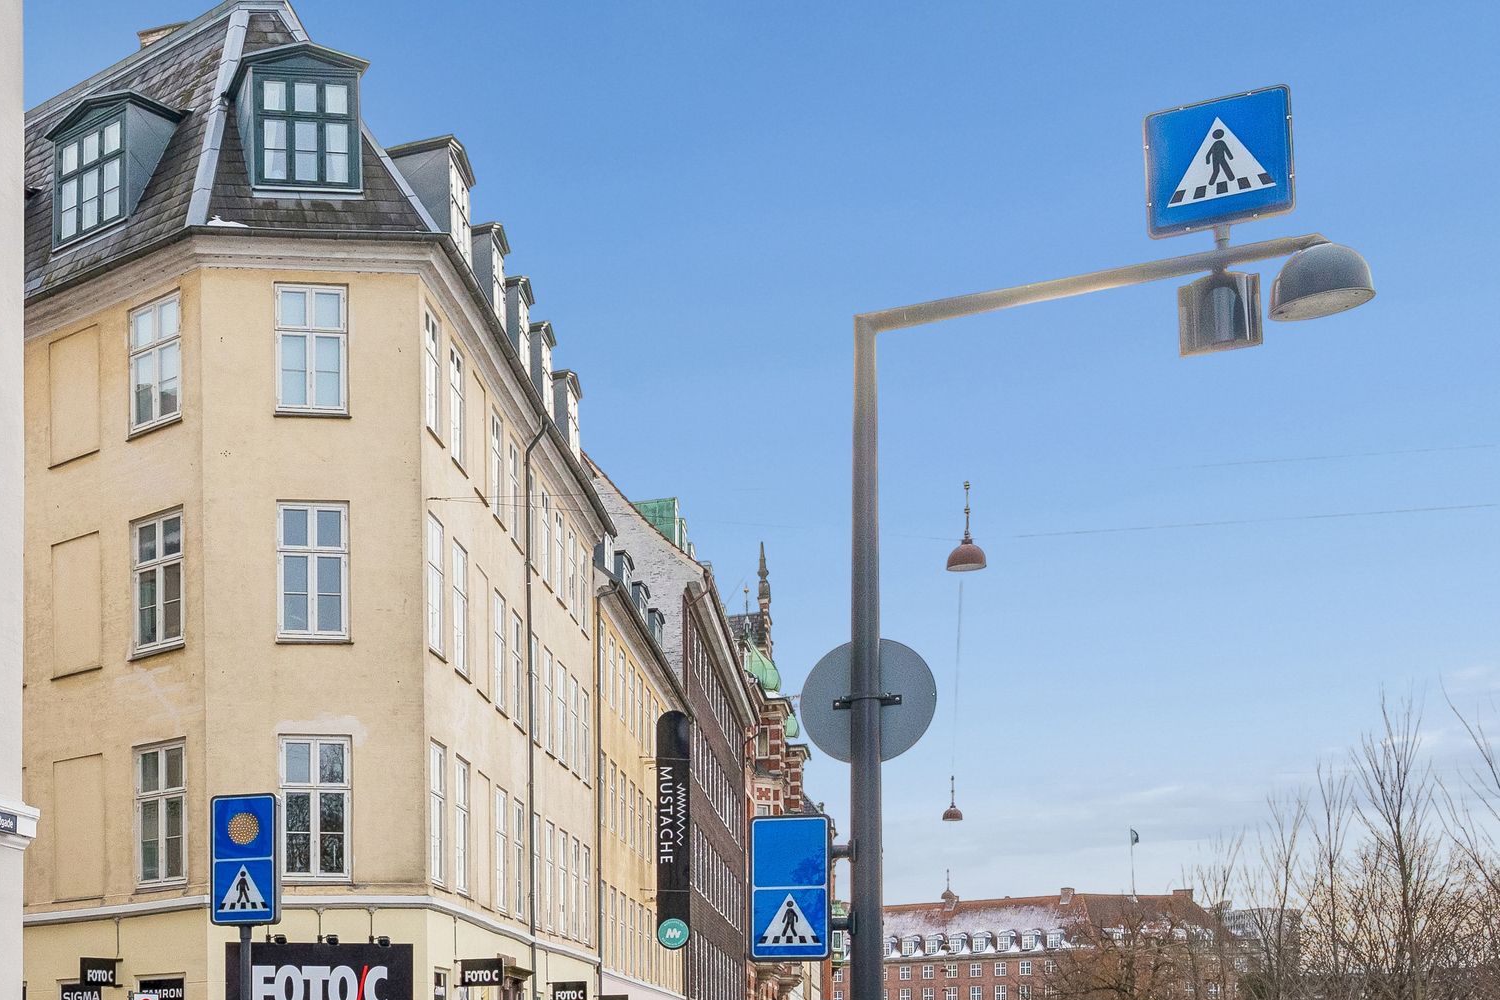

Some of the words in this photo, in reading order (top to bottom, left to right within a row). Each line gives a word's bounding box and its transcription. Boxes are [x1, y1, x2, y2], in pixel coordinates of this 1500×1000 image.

[660, 767, 673, 864] MUSTACHE
[87, 969, 107, 982] FOTO
[108, 970, 113, 982] C
[465, 971, 490, 982] FOTO
[491, 970, 499, 981] C
[556, 991, 576, 1000] FOTO
[578, 990, 583, 999] C
